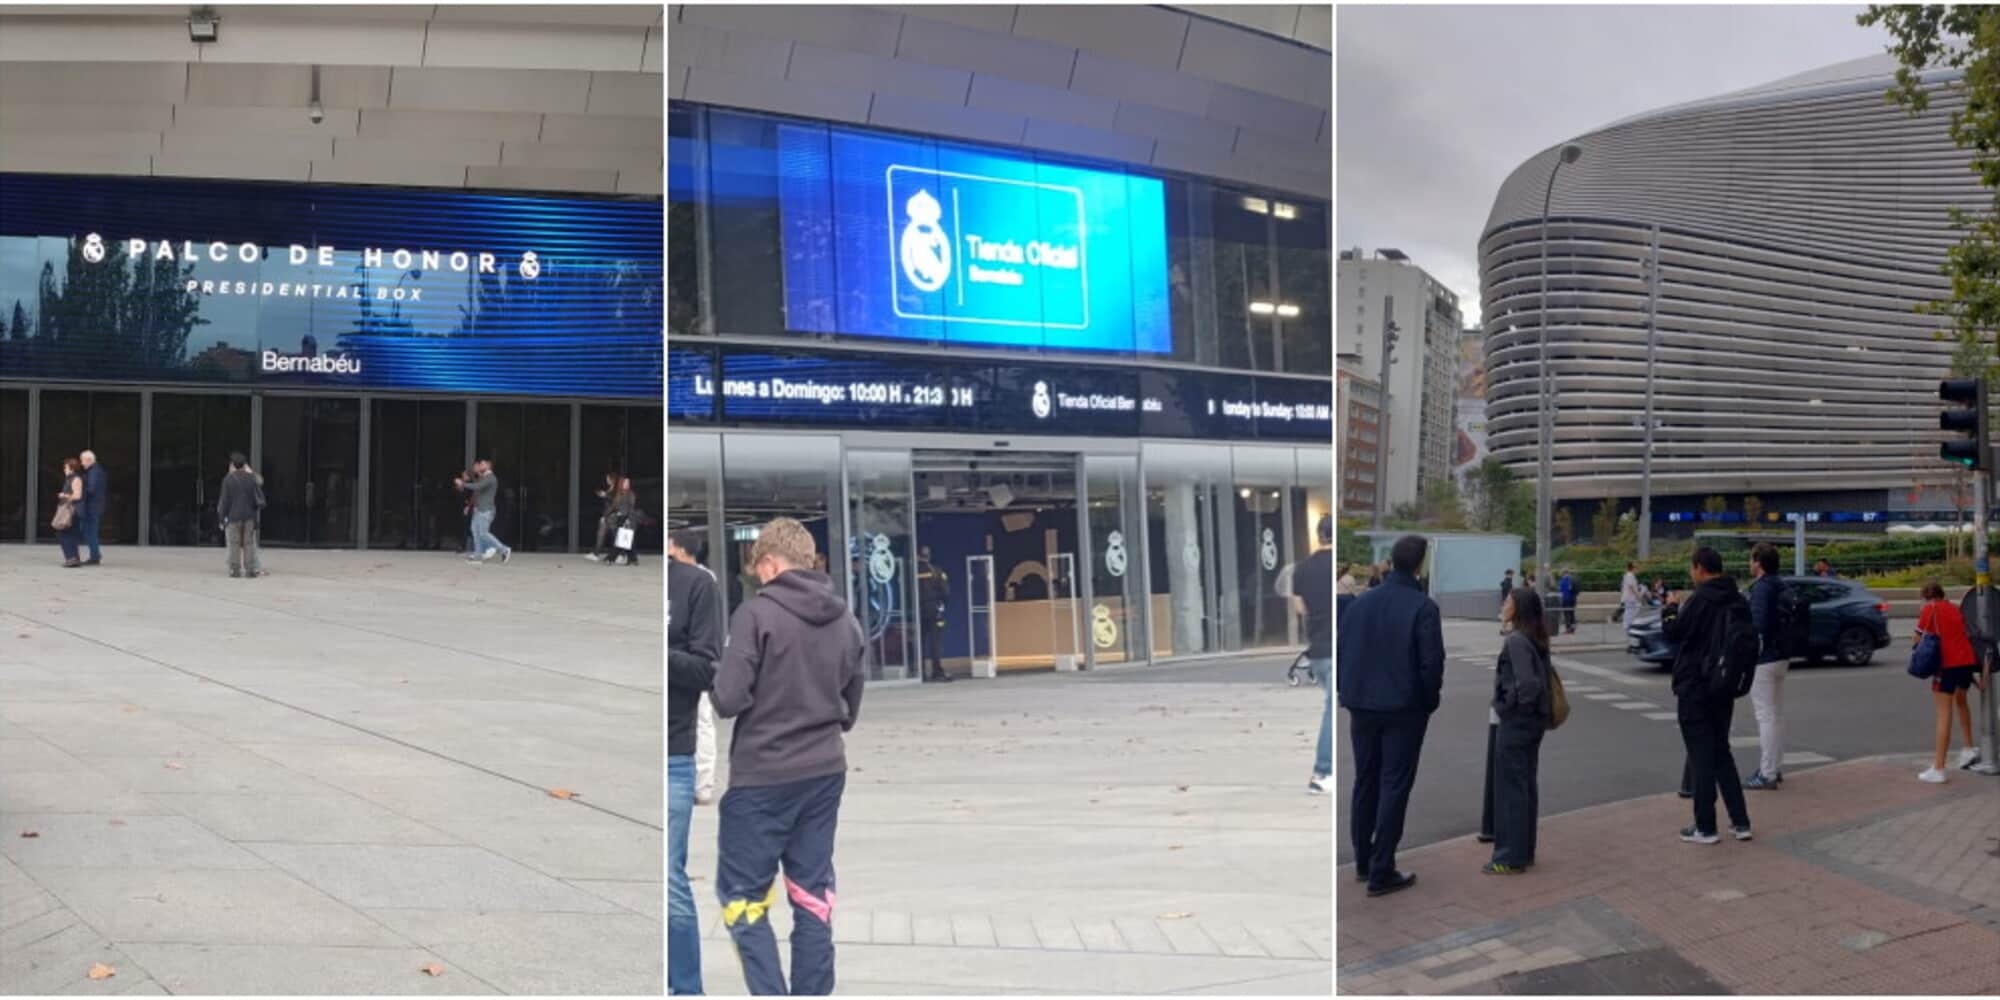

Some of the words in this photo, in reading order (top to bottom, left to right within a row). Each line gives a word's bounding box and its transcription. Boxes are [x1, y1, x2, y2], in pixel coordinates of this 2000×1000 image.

[128, 239, 259, 262] PALCO
[289, 245, 334, 266] DE
[364, 249, 496, 273] HONOR
[965, 234, 1024, 264] Tienda
[1026, 240, 1079, 270] Oficial
[186, 280, 364, 299] PRESIDENTIAL
[376, 287, 424, 301] BOX
[262, 351, 361, 374] Bernabéu
[759, 382, 769, 397] a
[772, 378, 846, 403] Domingo:
[849, 382, 886, 402] 10:00
[889, 384, 901, 402] H
[960, 388, 973, 406] H
[1058, 392, 1088, 408] Tienda
[1089, 394, 1116, 409] Oficial
